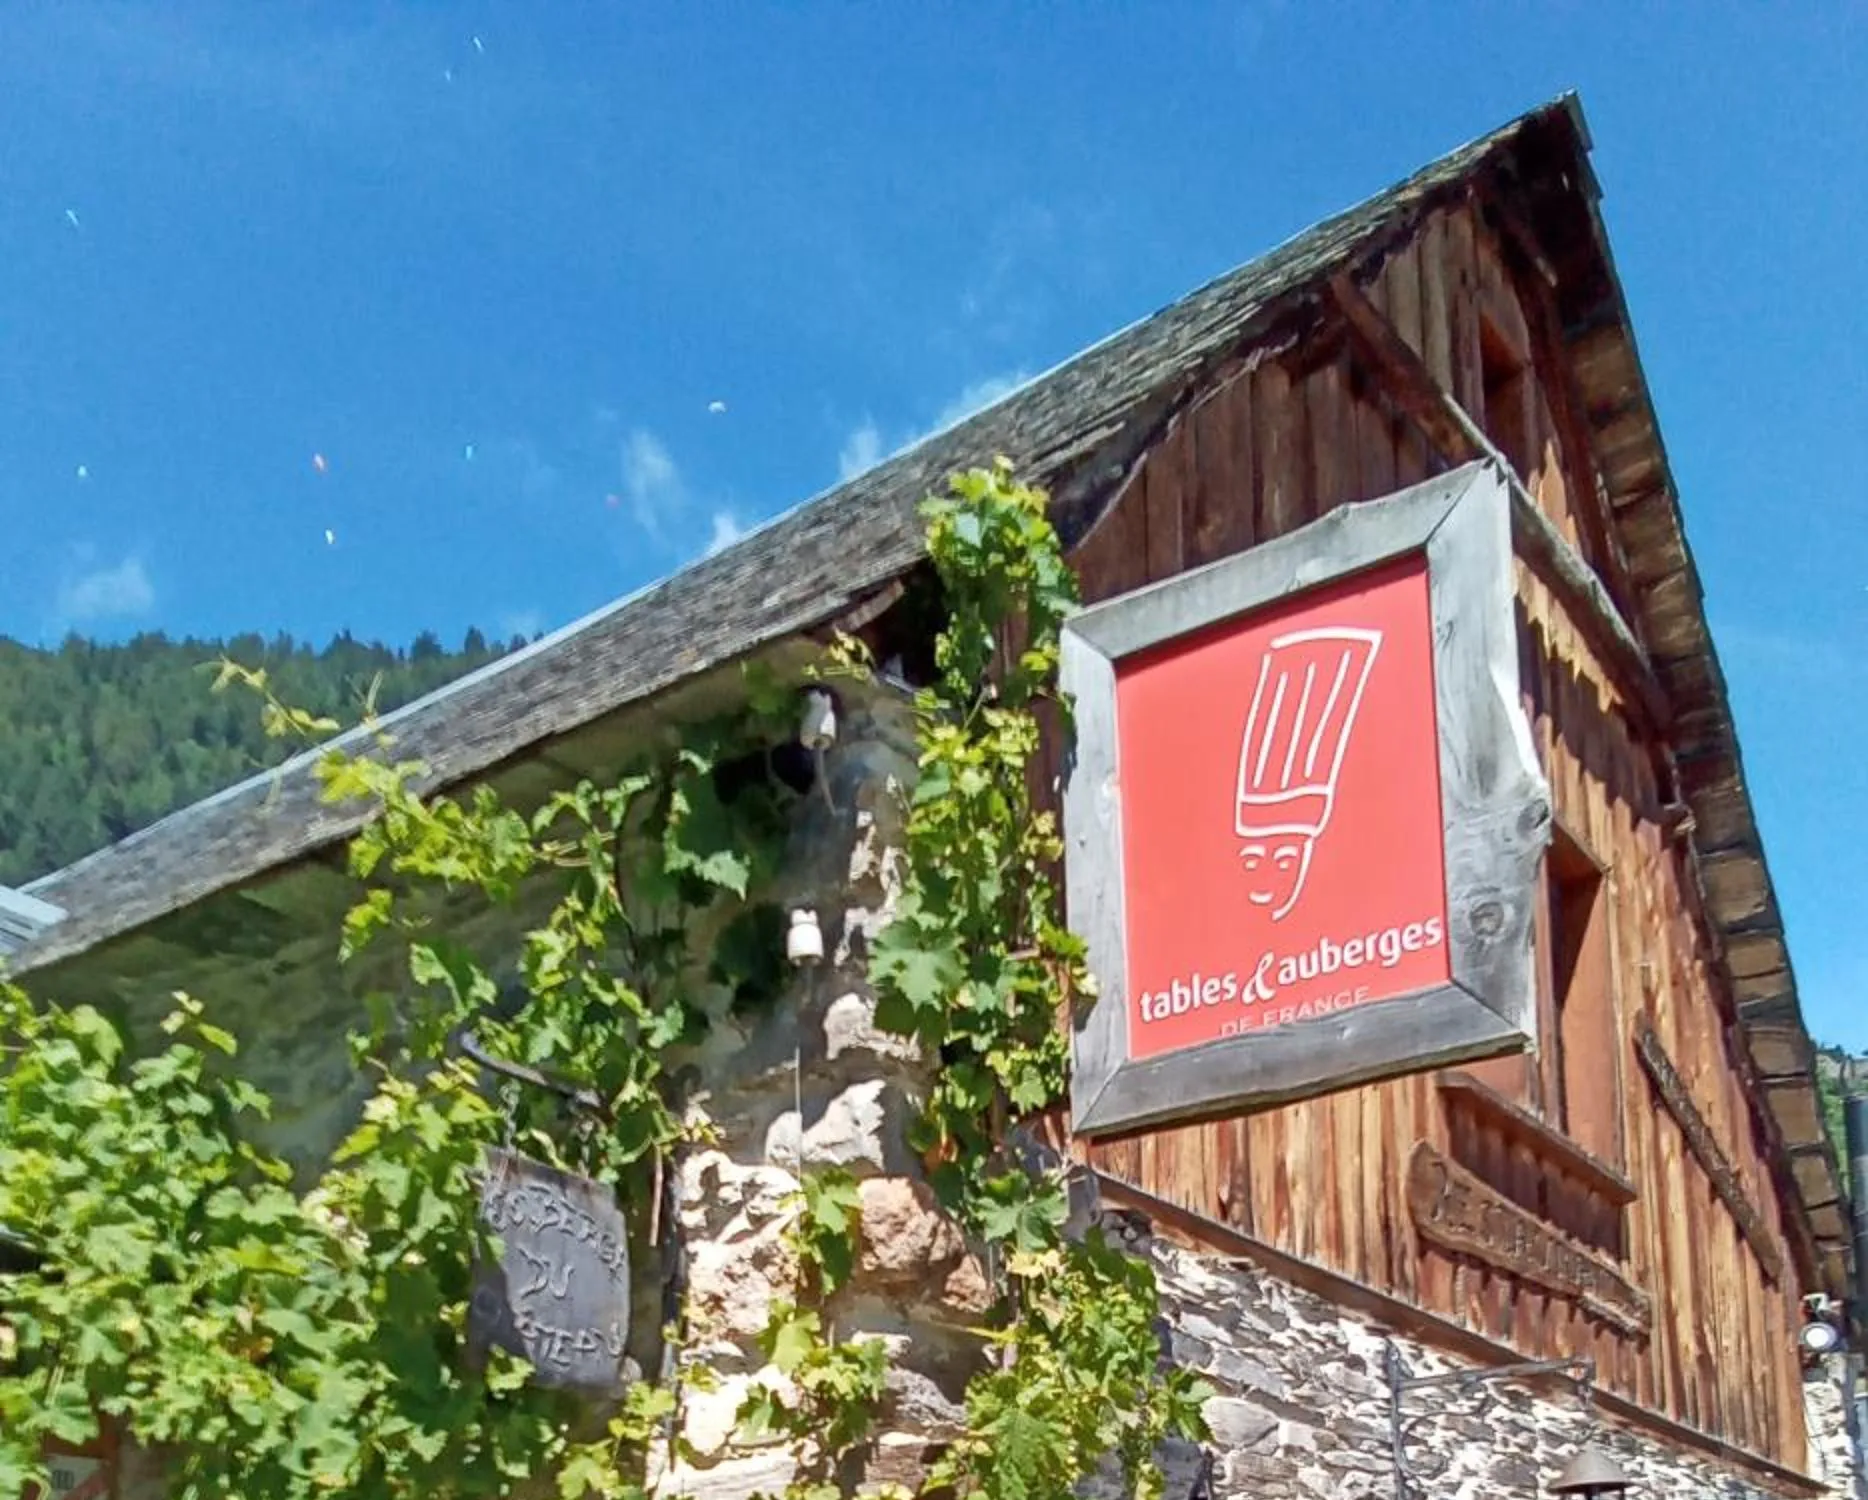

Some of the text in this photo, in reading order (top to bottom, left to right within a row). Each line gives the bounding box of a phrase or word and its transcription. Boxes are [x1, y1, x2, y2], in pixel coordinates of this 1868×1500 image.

[1140, 916, 1442, 1023] tables & auberges
[1221, 985, 1370, 1037] DE FRANCE
